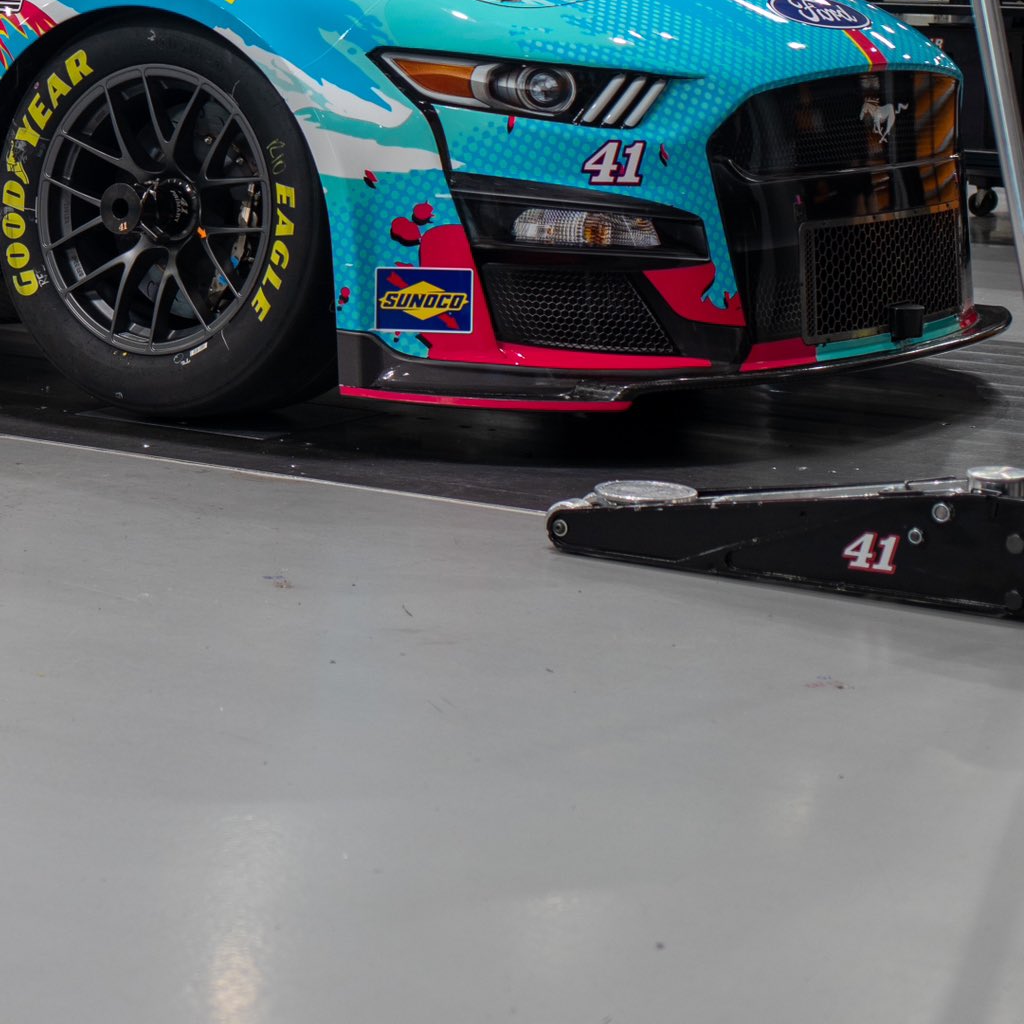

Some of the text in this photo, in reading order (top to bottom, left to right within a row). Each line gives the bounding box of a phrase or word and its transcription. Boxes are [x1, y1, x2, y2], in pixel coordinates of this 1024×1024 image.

[1, 49, 94, 297] GOODYEAR
[584, 141, 645, 185] 41
[251, 182, 296, 322] EAGLE
[383, 293, 465, 309] SUNOCO
[843, 533, 898, 573] 41
